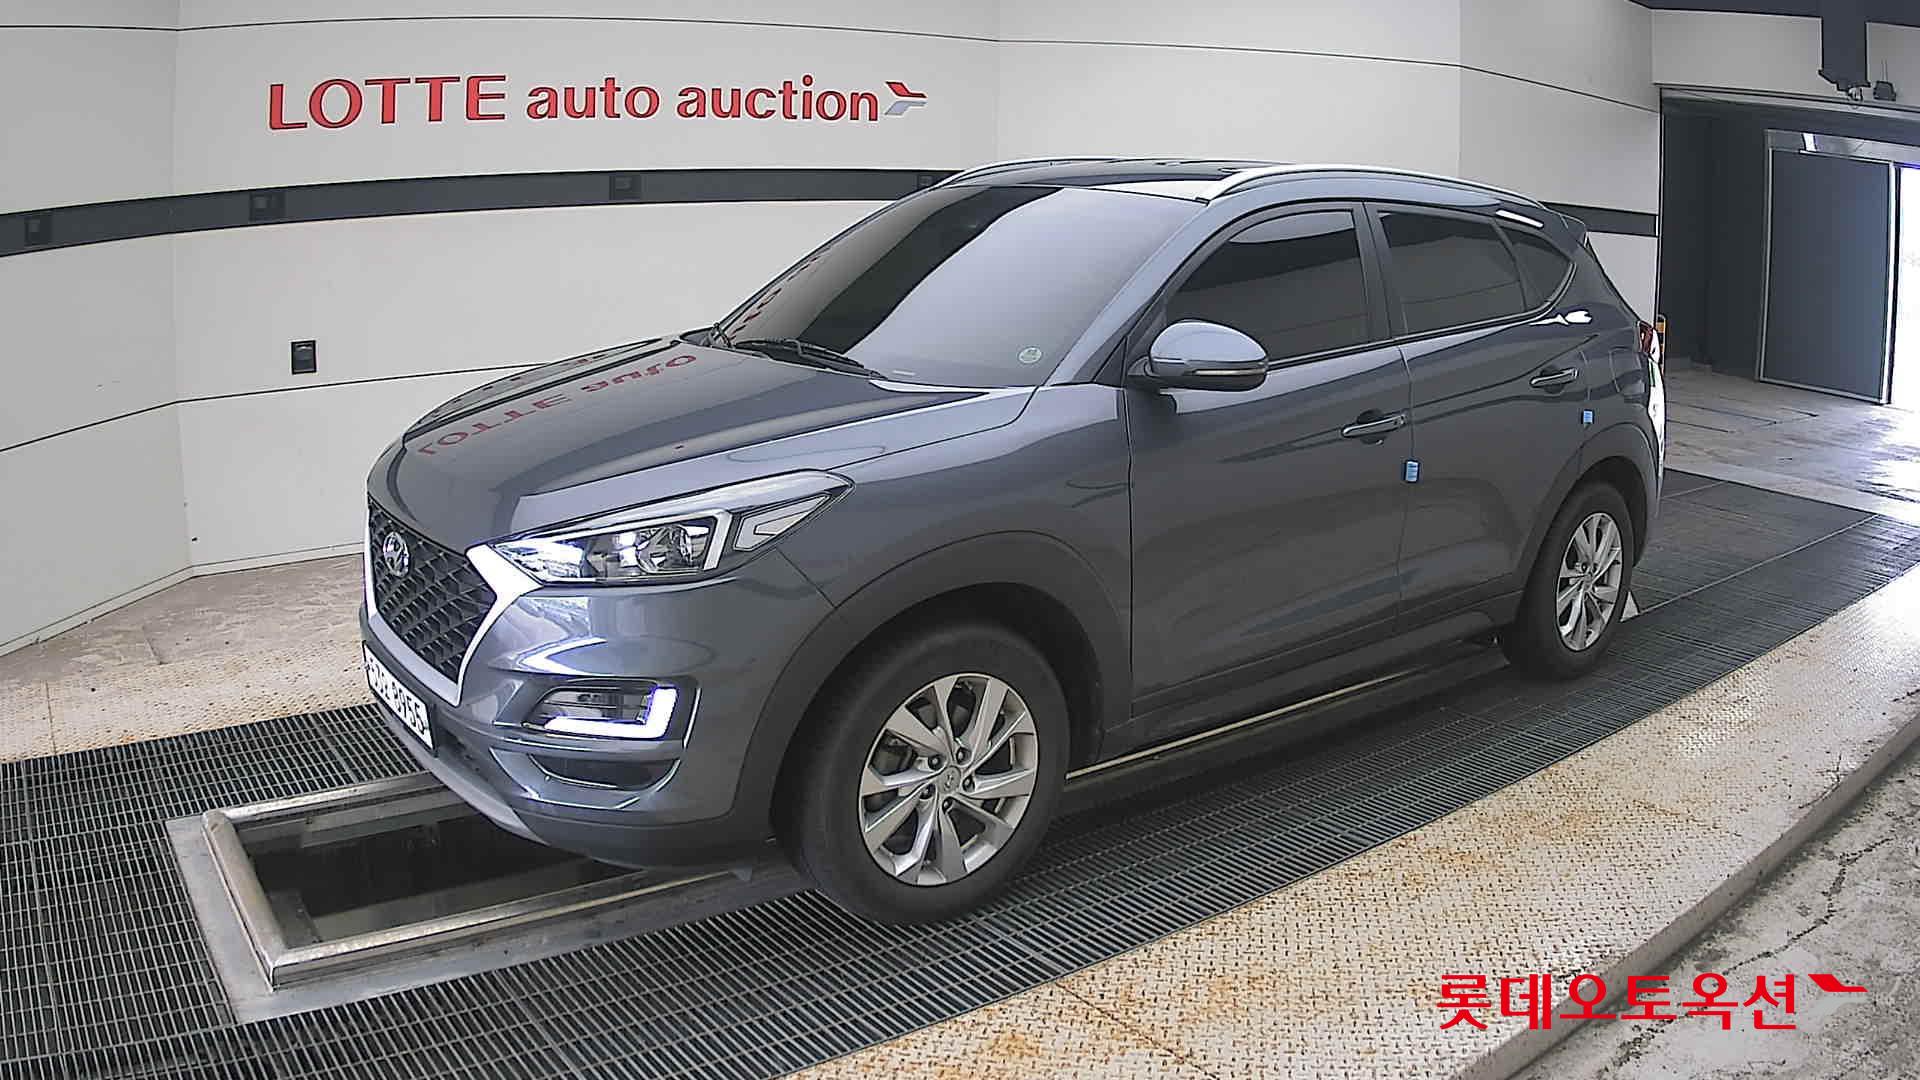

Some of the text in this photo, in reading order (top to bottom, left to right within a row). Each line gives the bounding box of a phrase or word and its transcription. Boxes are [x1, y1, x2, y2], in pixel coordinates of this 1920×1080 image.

[269, 74, 879, 130] LOTTE auto auction
